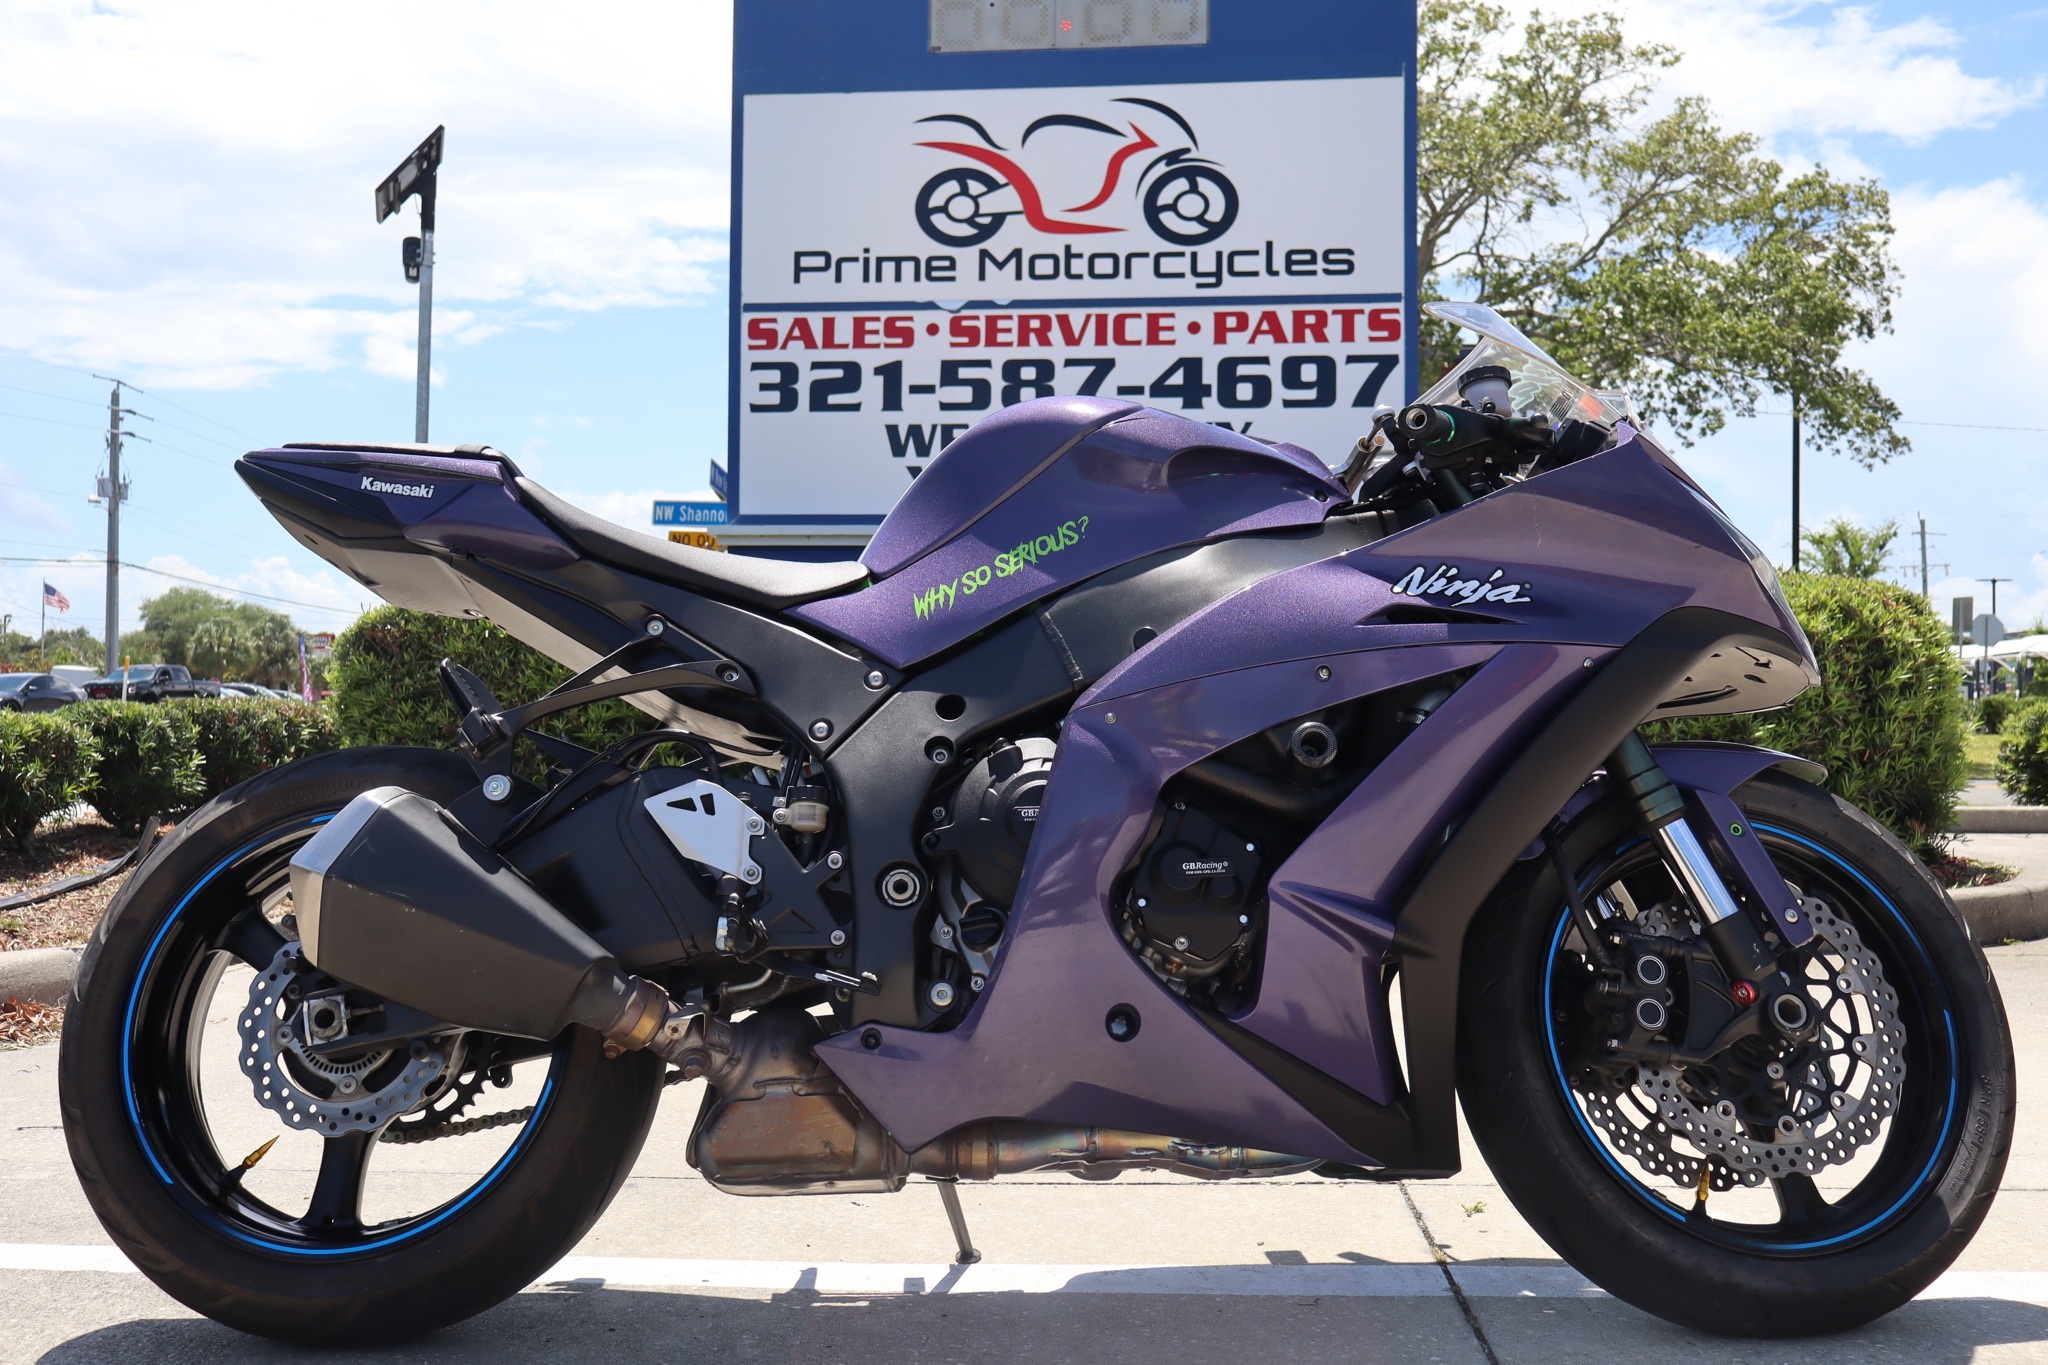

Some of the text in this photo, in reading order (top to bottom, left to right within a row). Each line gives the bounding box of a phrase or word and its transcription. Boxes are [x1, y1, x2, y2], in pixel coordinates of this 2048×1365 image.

[793, 241, 1355, 289] Prime Motorcycles
[747, 308, 1401, 350] SALES SERVICE PARTS
[749, 354, 1400, 413] 321-587-4697
[360, 476, 435, 498] Kawasaki
[655, 505, 728, 522] NW Shanno
[913, 515, 1090, 621] WHY SO SERIOUS?
[1391, 565, 1532, 607] Ninja
